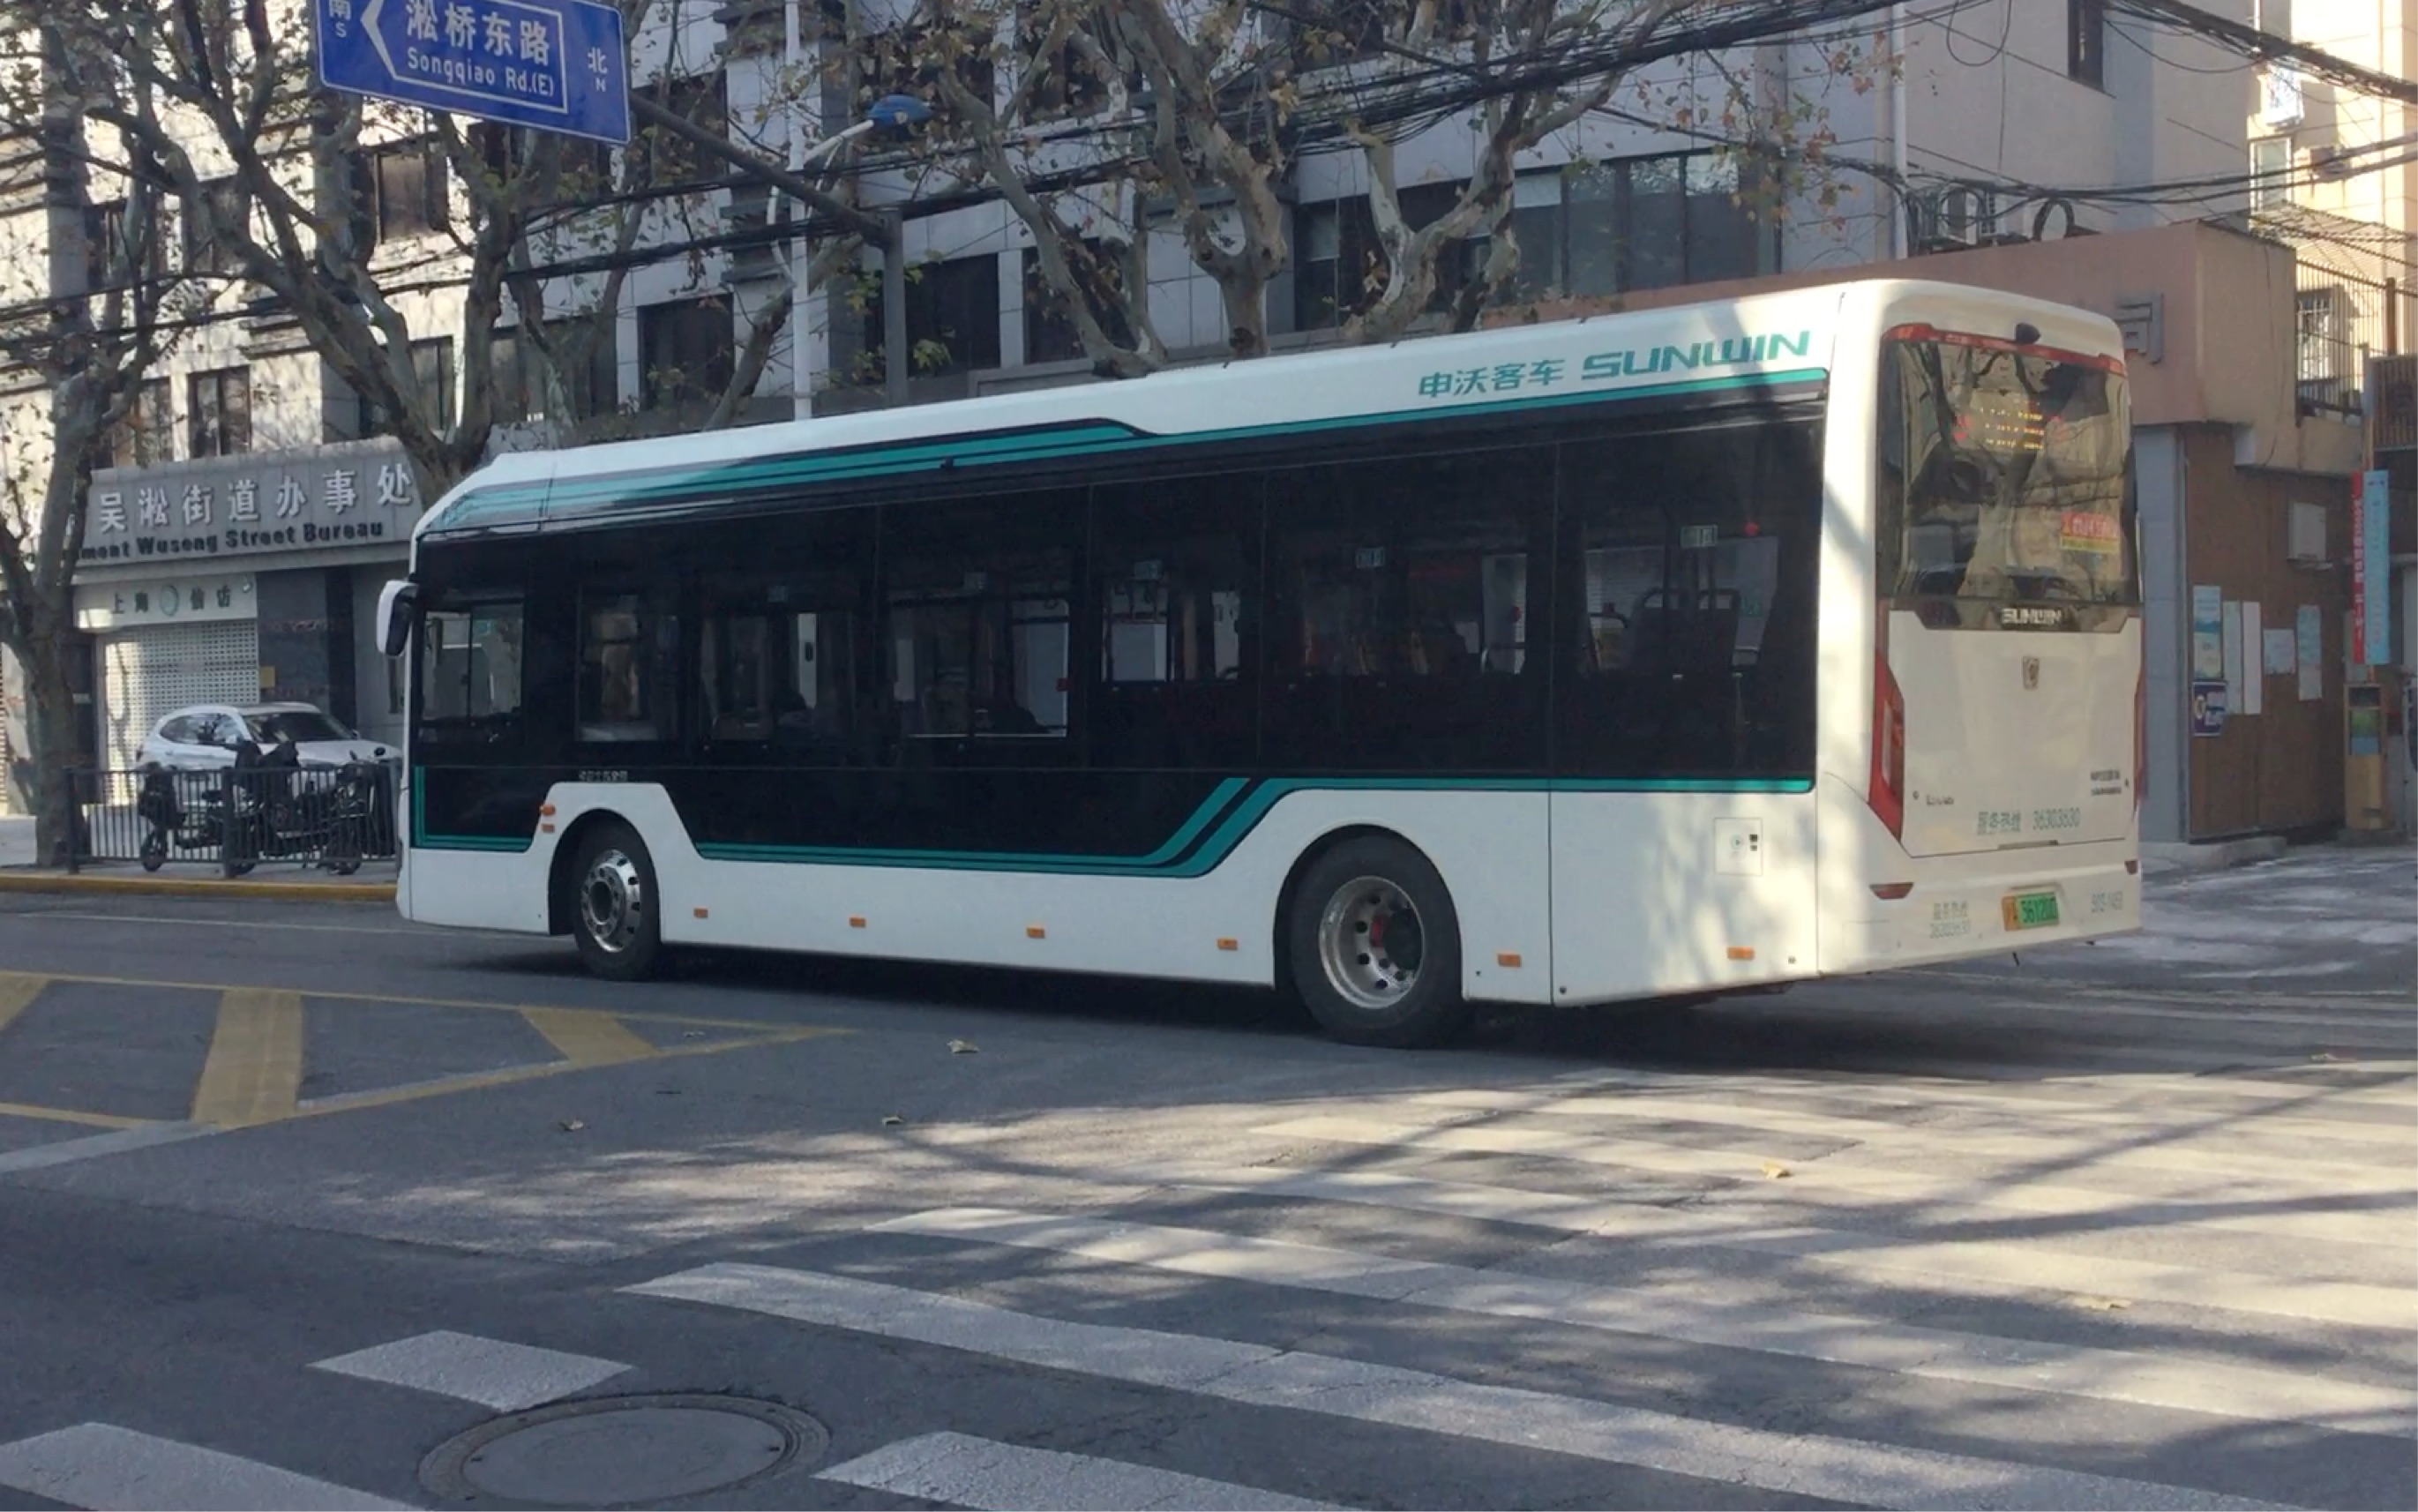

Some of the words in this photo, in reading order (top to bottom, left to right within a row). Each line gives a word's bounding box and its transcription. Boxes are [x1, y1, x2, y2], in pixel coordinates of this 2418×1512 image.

[336, 23, 347, 38] S
[406, 0, 550, 66] 淞桥东路
[407, 47, 495, 86] Songqiao
[505, 68, 554, 96] Rd.(E)
[588, 48, 608, 74] 北
[595, 77, 606, 92] N
[1418, 358, 1564, 399] 申沃客车
[1582, 330, 1810, 379] SUNWIN
[99, 463, 414, 534] 吴淞街道办事处
[226, 529, 296, 549] Street
[303, 520, 383, 543] Bureau
